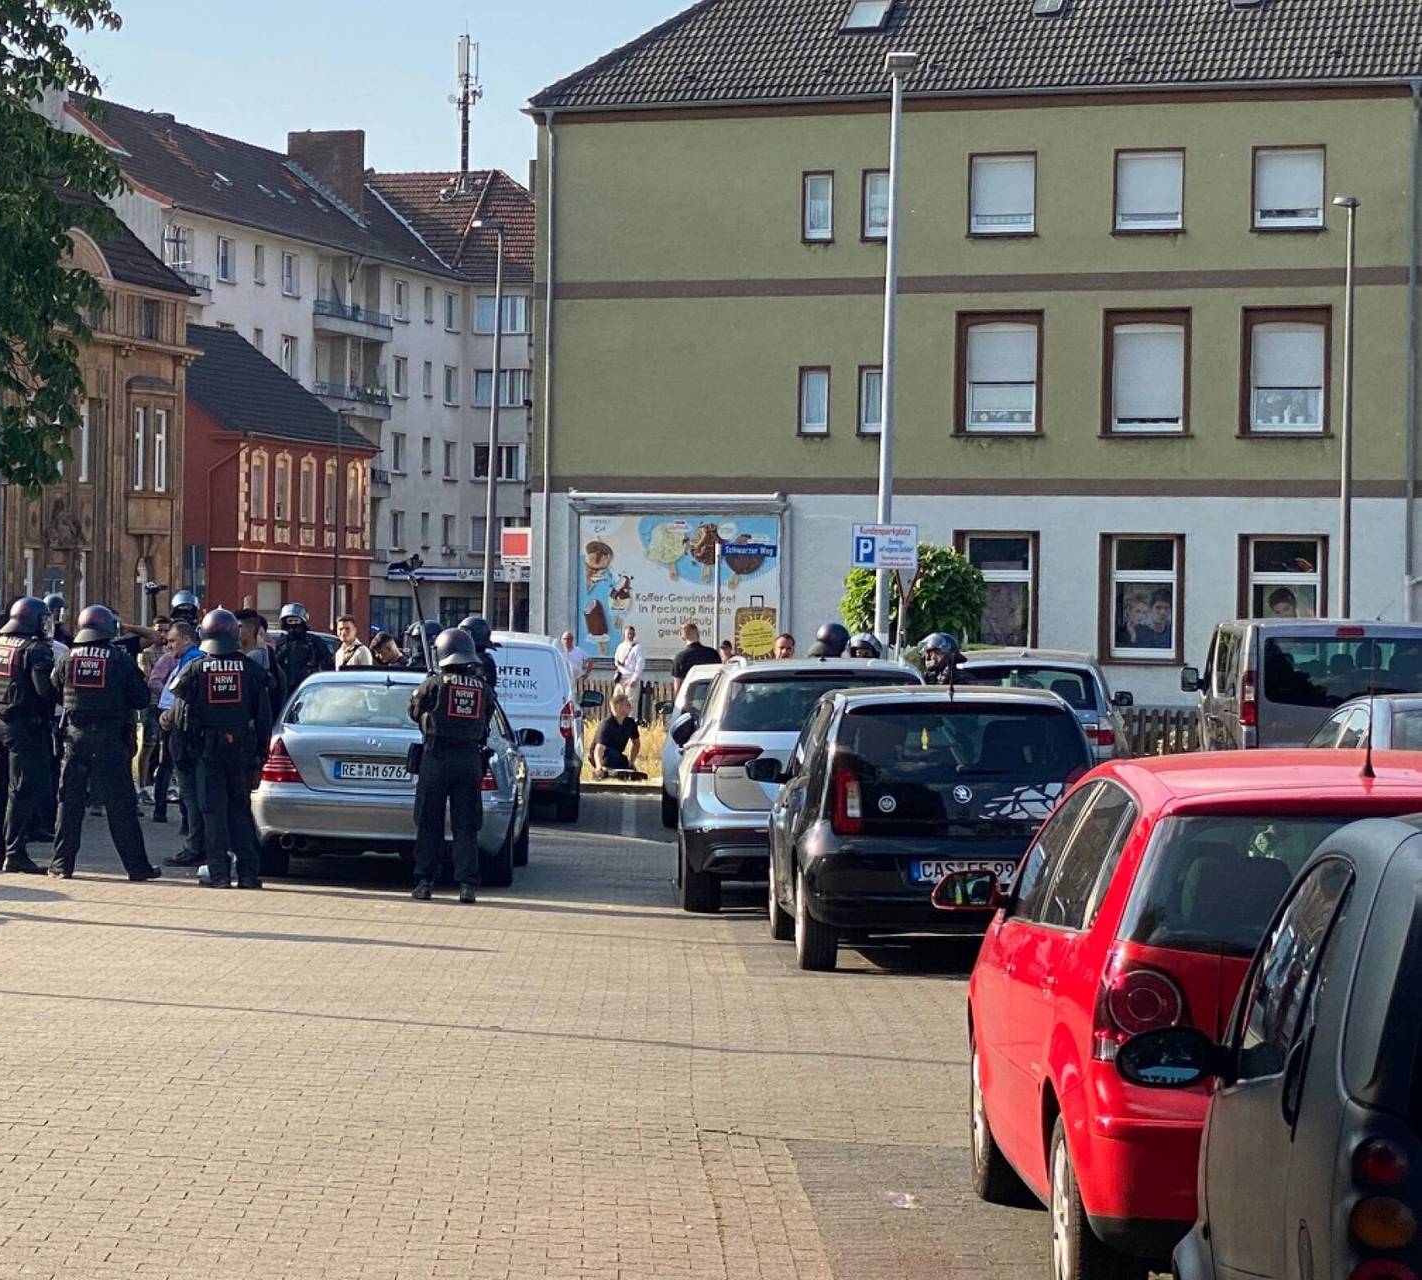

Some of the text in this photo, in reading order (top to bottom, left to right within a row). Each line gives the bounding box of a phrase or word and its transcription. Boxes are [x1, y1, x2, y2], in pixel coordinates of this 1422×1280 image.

[725, 545, 774, 555] Schwarzer Weg
[635, 592, 736, 602] Koffer-Gewinntiket
[651, 604, 696, 615] Packung
[657, 616, 676, 625] und
[70, 646, 110, 658] POLIZEI
[80, 661, 99, 669] NRW
[203, 660, 244, 672] POLIZEI
[498, 666, 530, 676] HTER
[215, 675, 233, 684] NRW
[496, 678, 538, 689] ECHNIK
[342, 764, 356, 776] RE
[365, 765, 379, 777] AM
[922, 862, 955, 878] CAS
[994, 862, 1015, 878] 99
